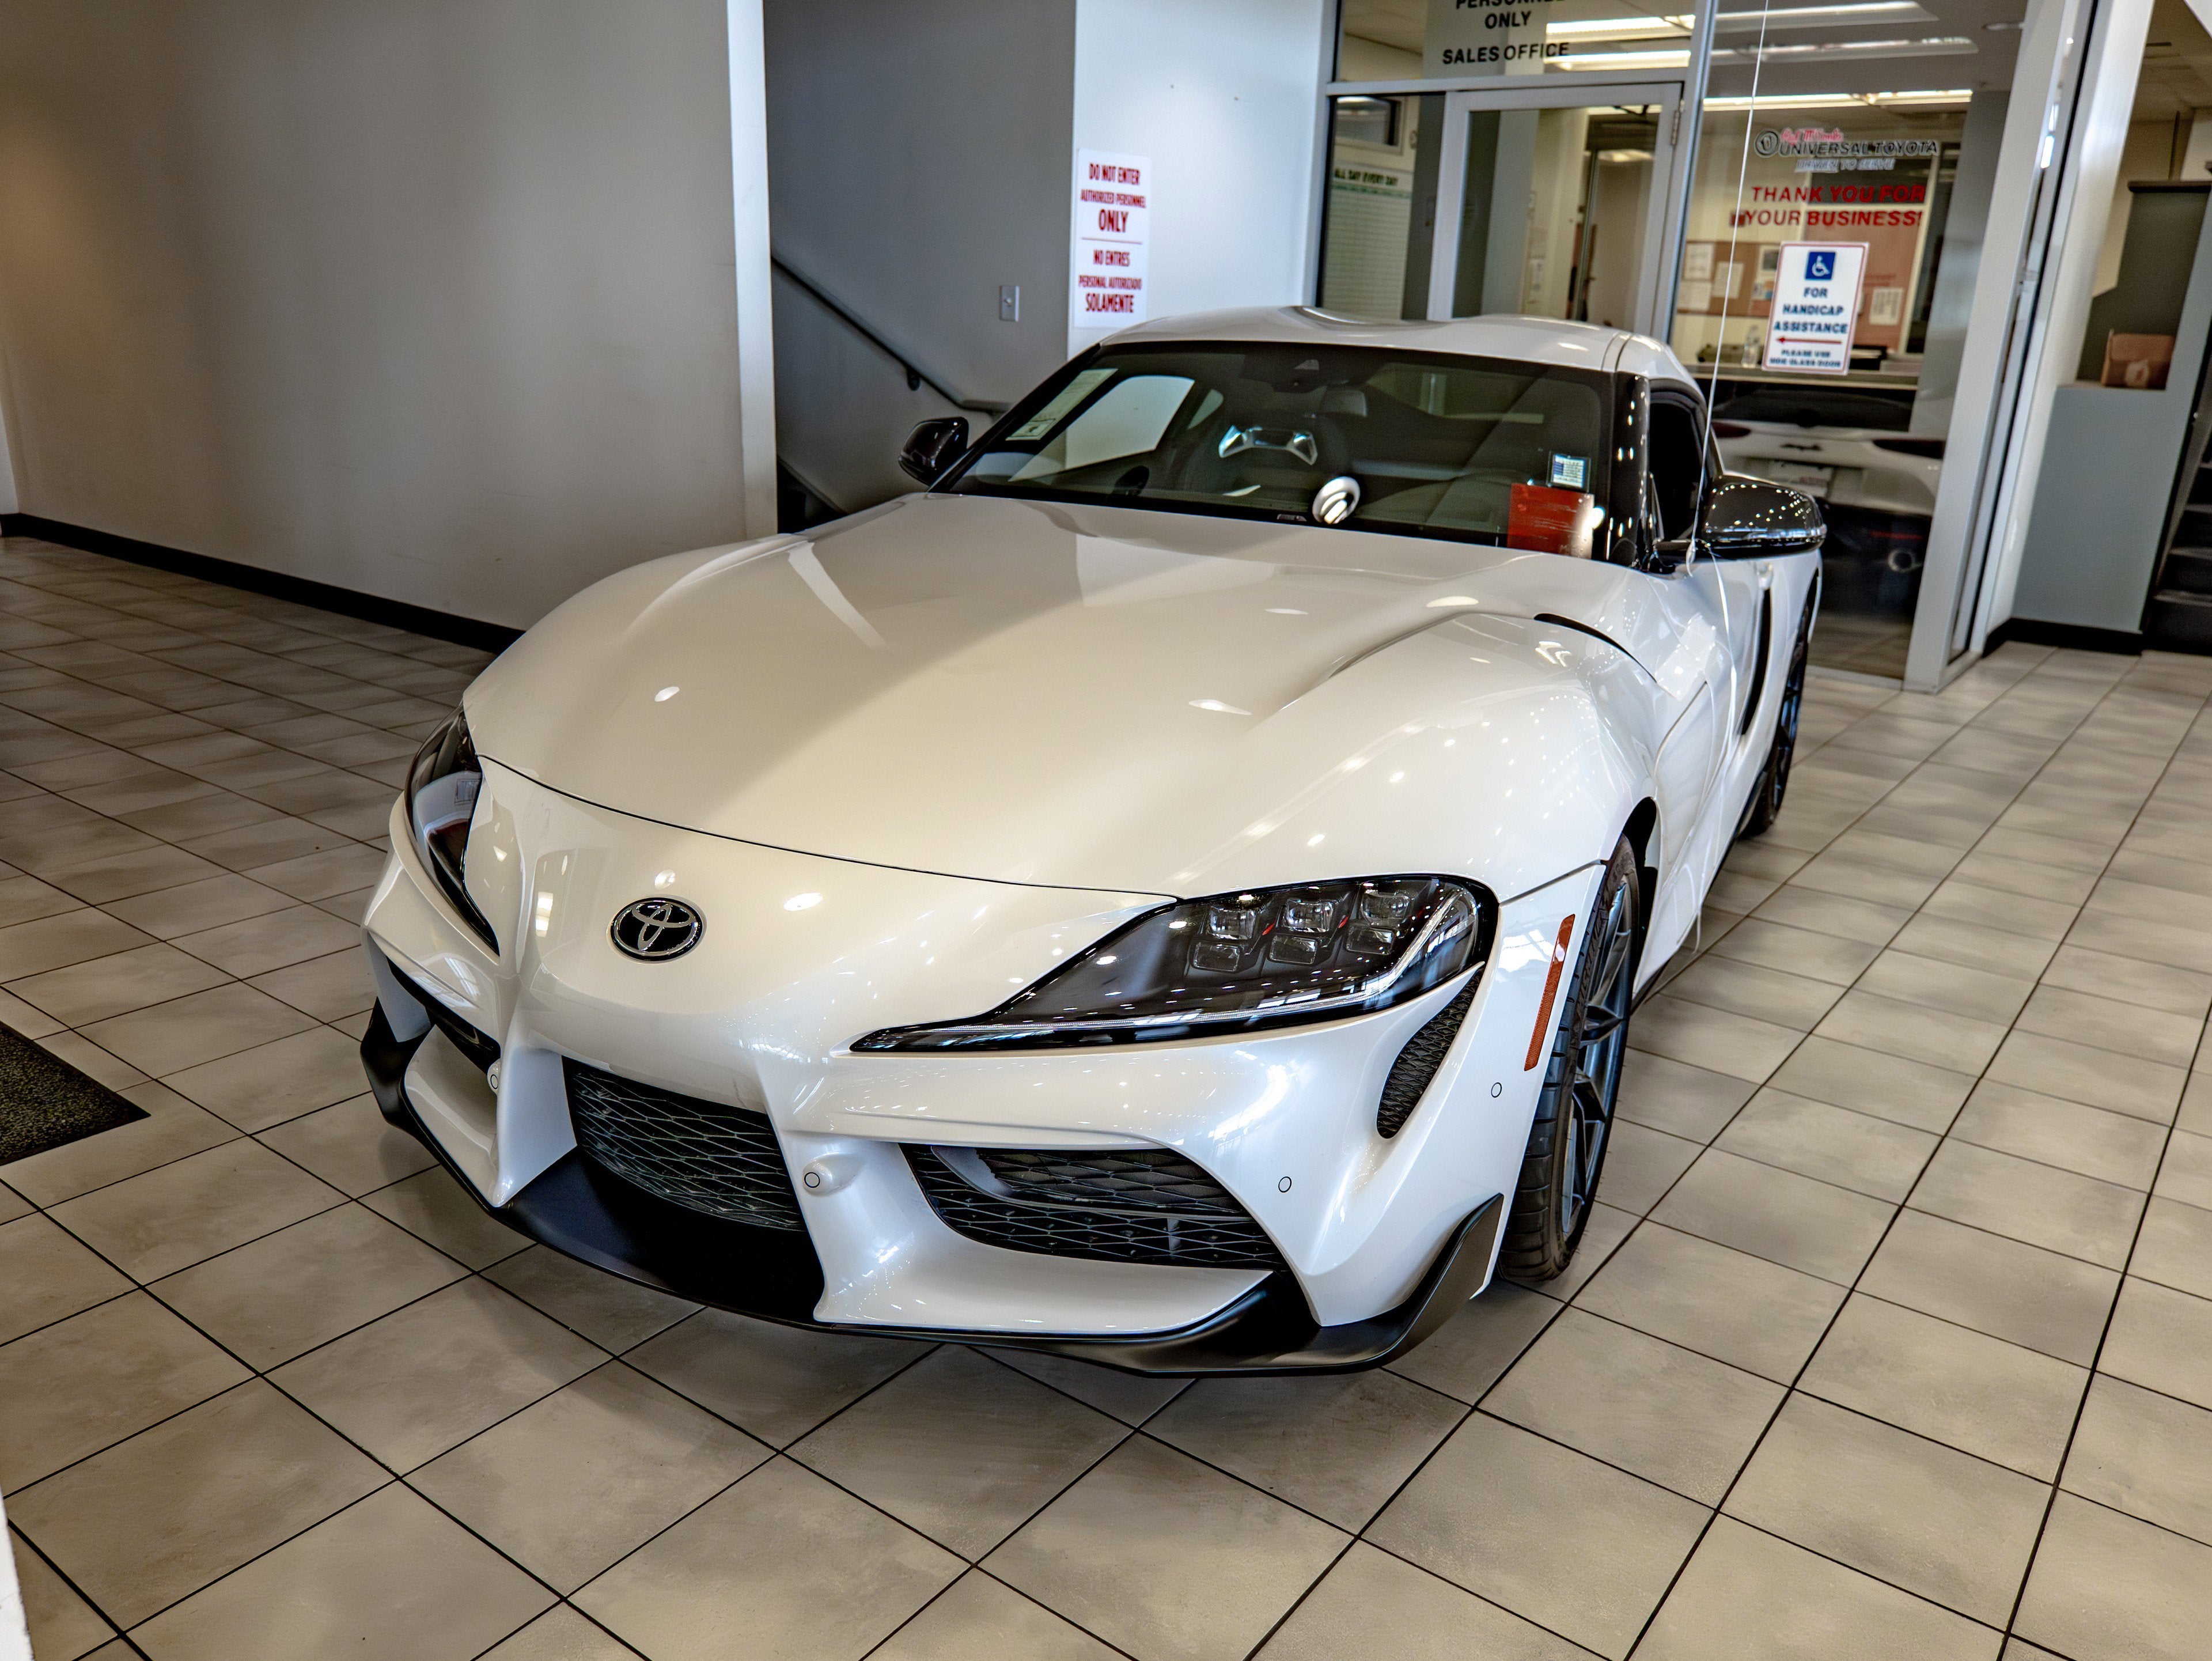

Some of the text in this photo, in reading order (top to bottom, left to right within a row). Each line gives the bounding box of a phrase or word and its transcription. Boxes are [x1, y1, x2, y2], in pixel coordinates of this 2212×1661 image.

[1484, 10, 1531, 29] ONLY
[1442, 42, 1569, 64] SALES OFFICE
[1779, 140, 1938, 156] UNIVERSAL TOYOTA
[1089, 162, 1140, 185] DO NOT ENTER
[1081, 189, 1146, 208] AUTHORIZED PERSONNEL
[1752, 184, 1926, 203] THANK YOU FOR
[1099, 209, 1129, 233] ONLY
[1745, 210, 1922, 226] YOUR BUSINESS!
[1093, 249, 1130, 267] NO ENTRIES
[1078, 275, 1107, 288] PERSONAL
[1804, 287, 1828, 298] FOR
[1086, 293, 1134, 313] SOLAMENTE
[1783, 304, 1844, 316] HANDICAP
[1774, 321, 1848, 334] ASSISTANCE
